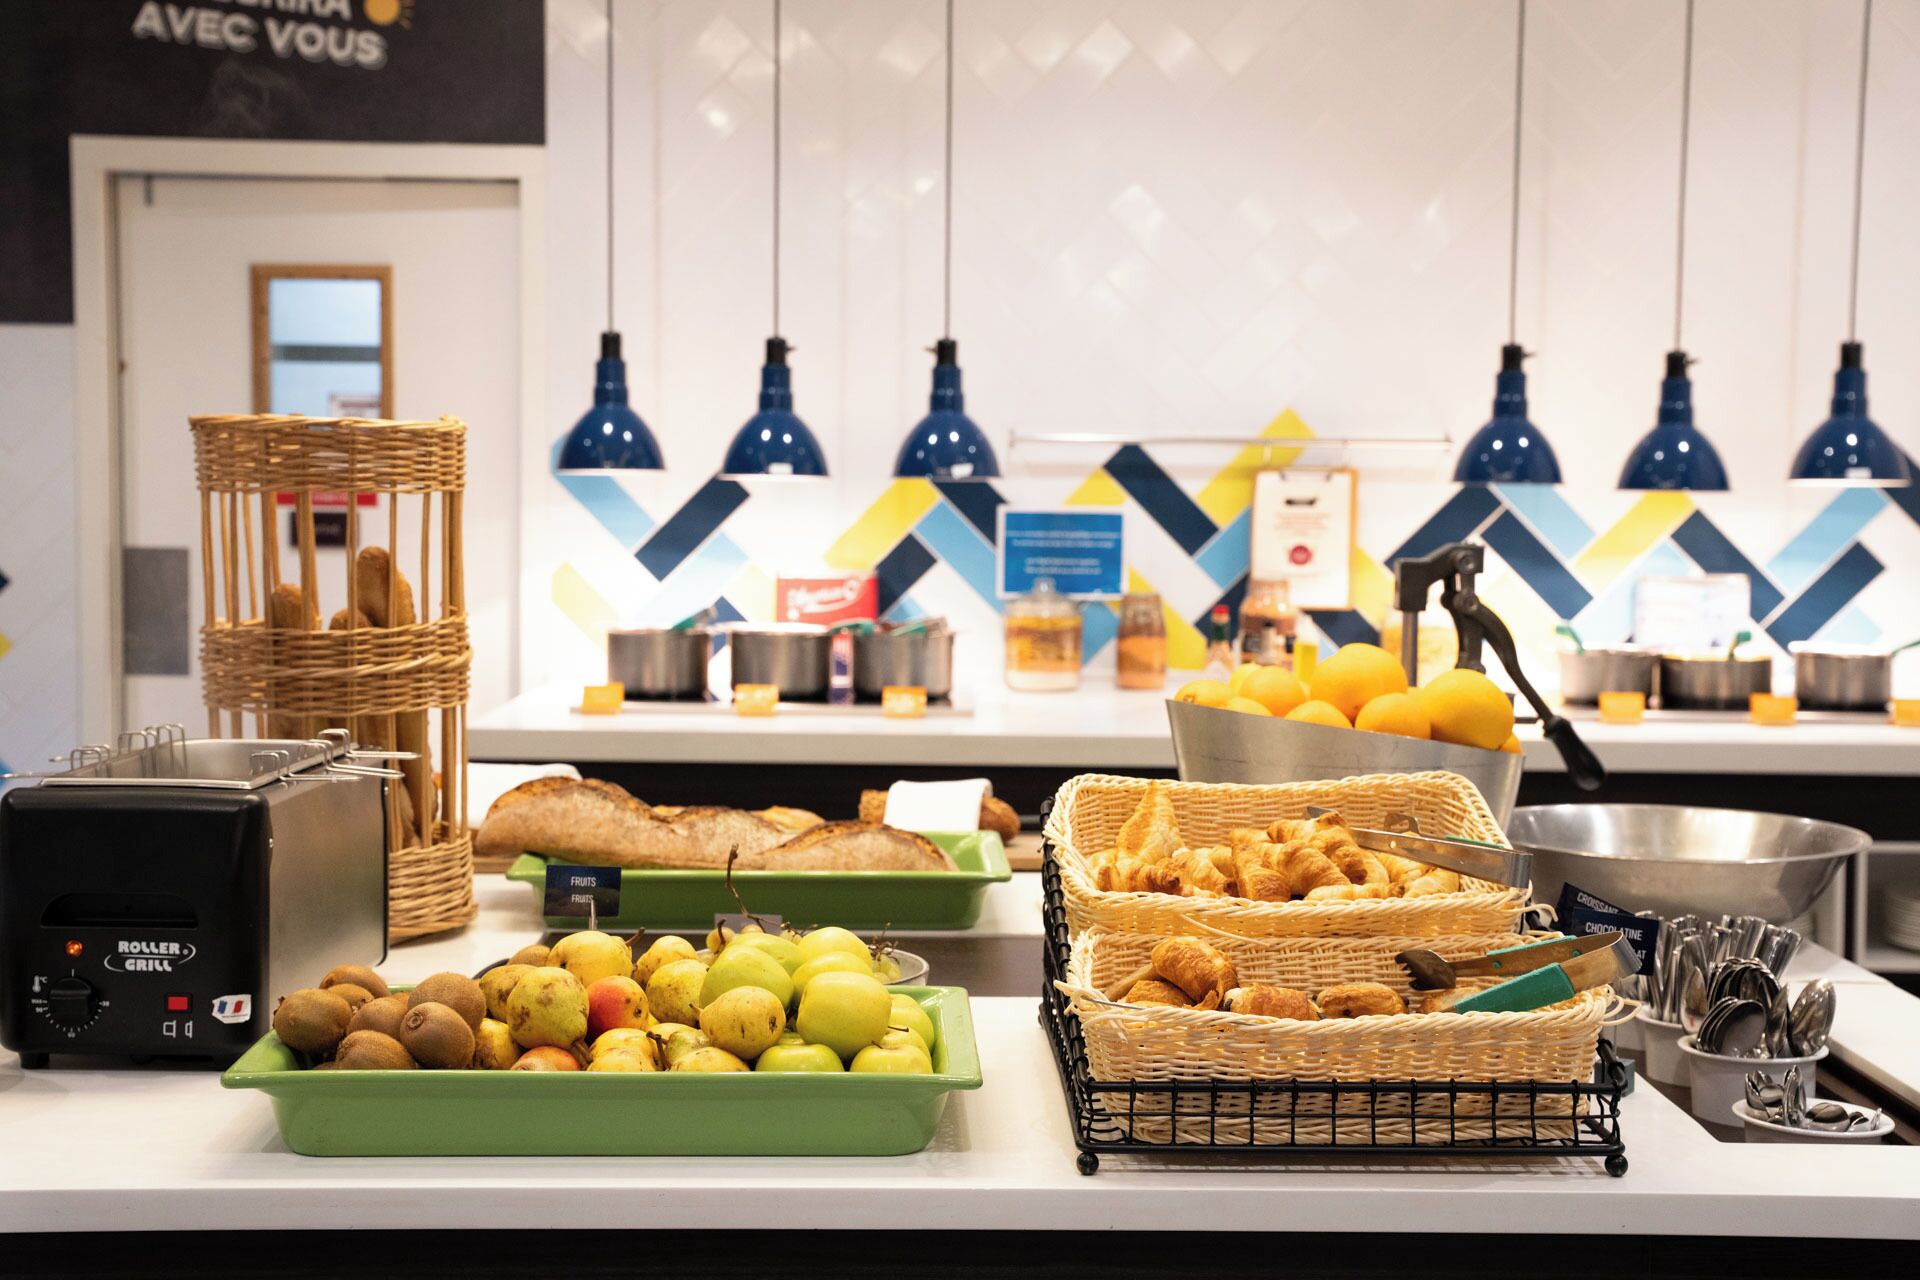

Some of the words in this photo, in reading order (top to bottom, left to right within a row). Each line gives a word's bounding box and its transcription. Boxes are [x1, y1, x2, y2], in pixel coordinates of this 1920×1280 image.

[132, 1, 258, 52] AVEC
[265, 17, 387, 70] VOUS
[570, 876, 597, 887] FRUITS
[571, 893, 594, 903] FRUITS
[118, 941, 180, 954] ROLLER
[125, 958, 172, 972] GRILL
